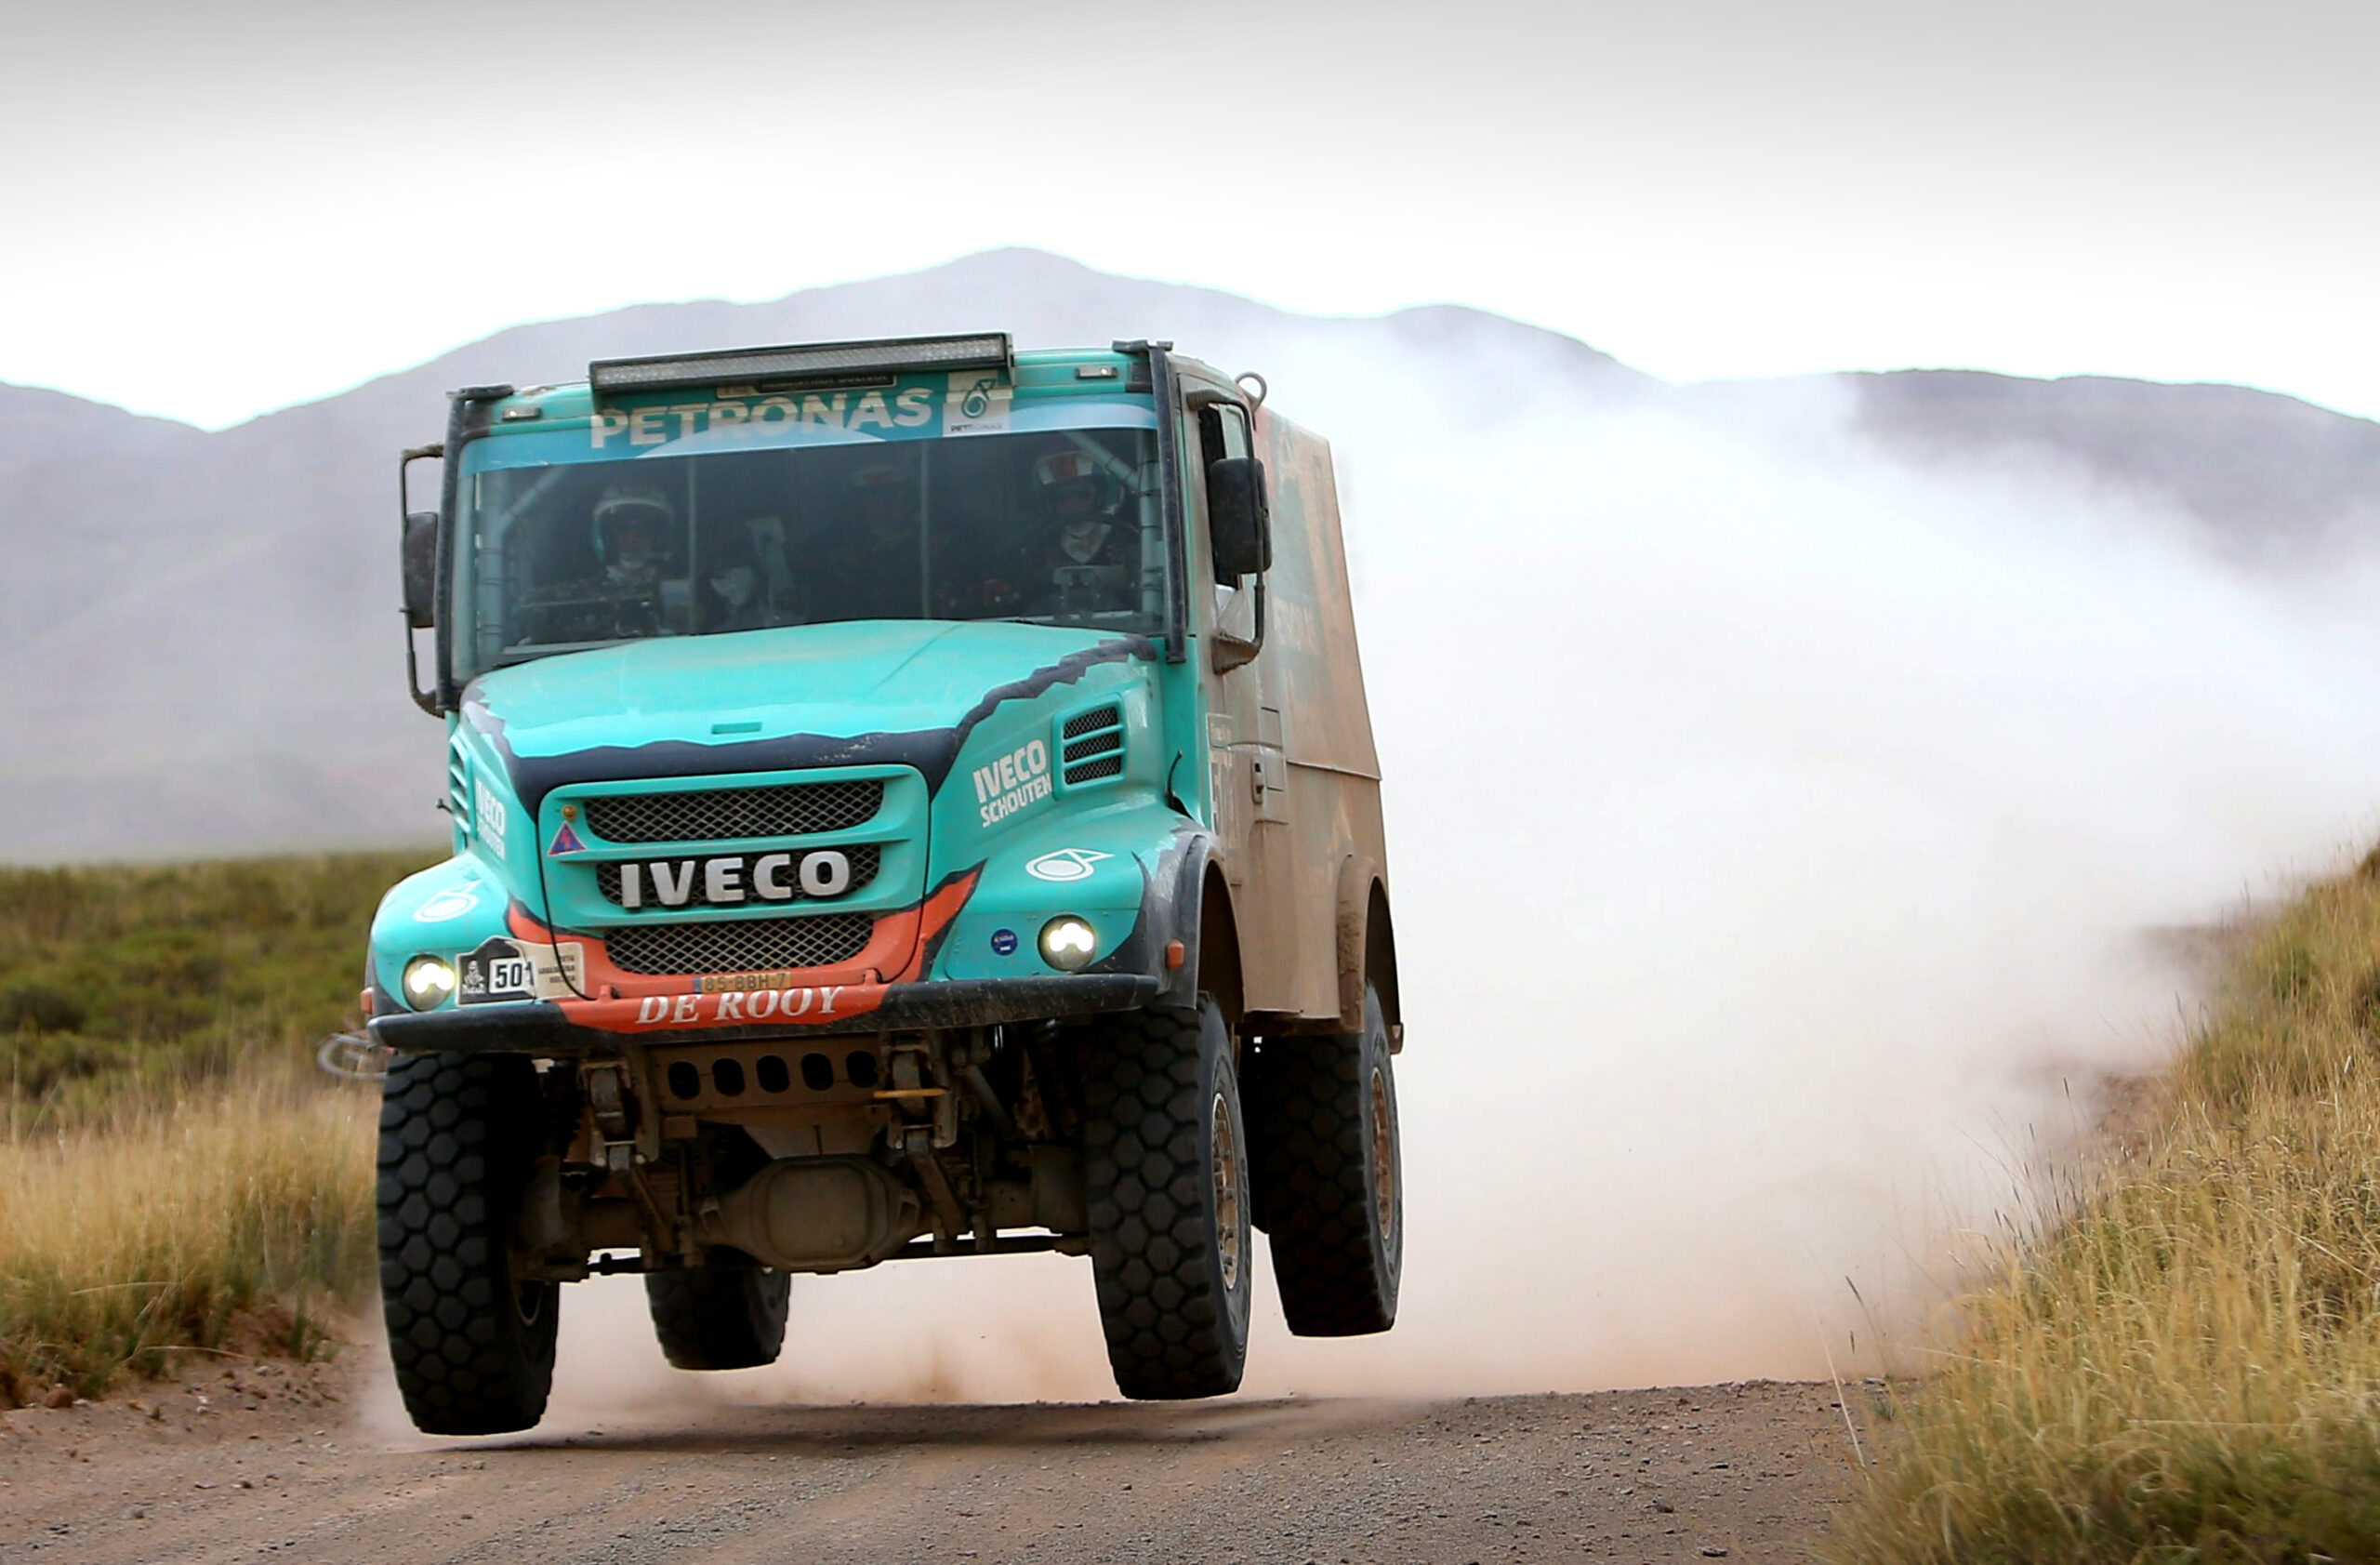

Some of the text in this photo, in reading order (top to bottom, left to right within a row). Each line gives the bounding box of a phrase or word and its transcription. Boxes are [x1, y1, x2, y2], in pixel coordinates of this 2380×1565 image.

[589, 387, 934, 449] PETRONAS
[972, 738, 1047, 803] IVECO
[980, 772, 1052, 828] SCHOUTEN
[619, 850, 852, 908] IVECO
[495, 961, 535, 988] 501
[635, 986, 844, 1025] DE ROOY
